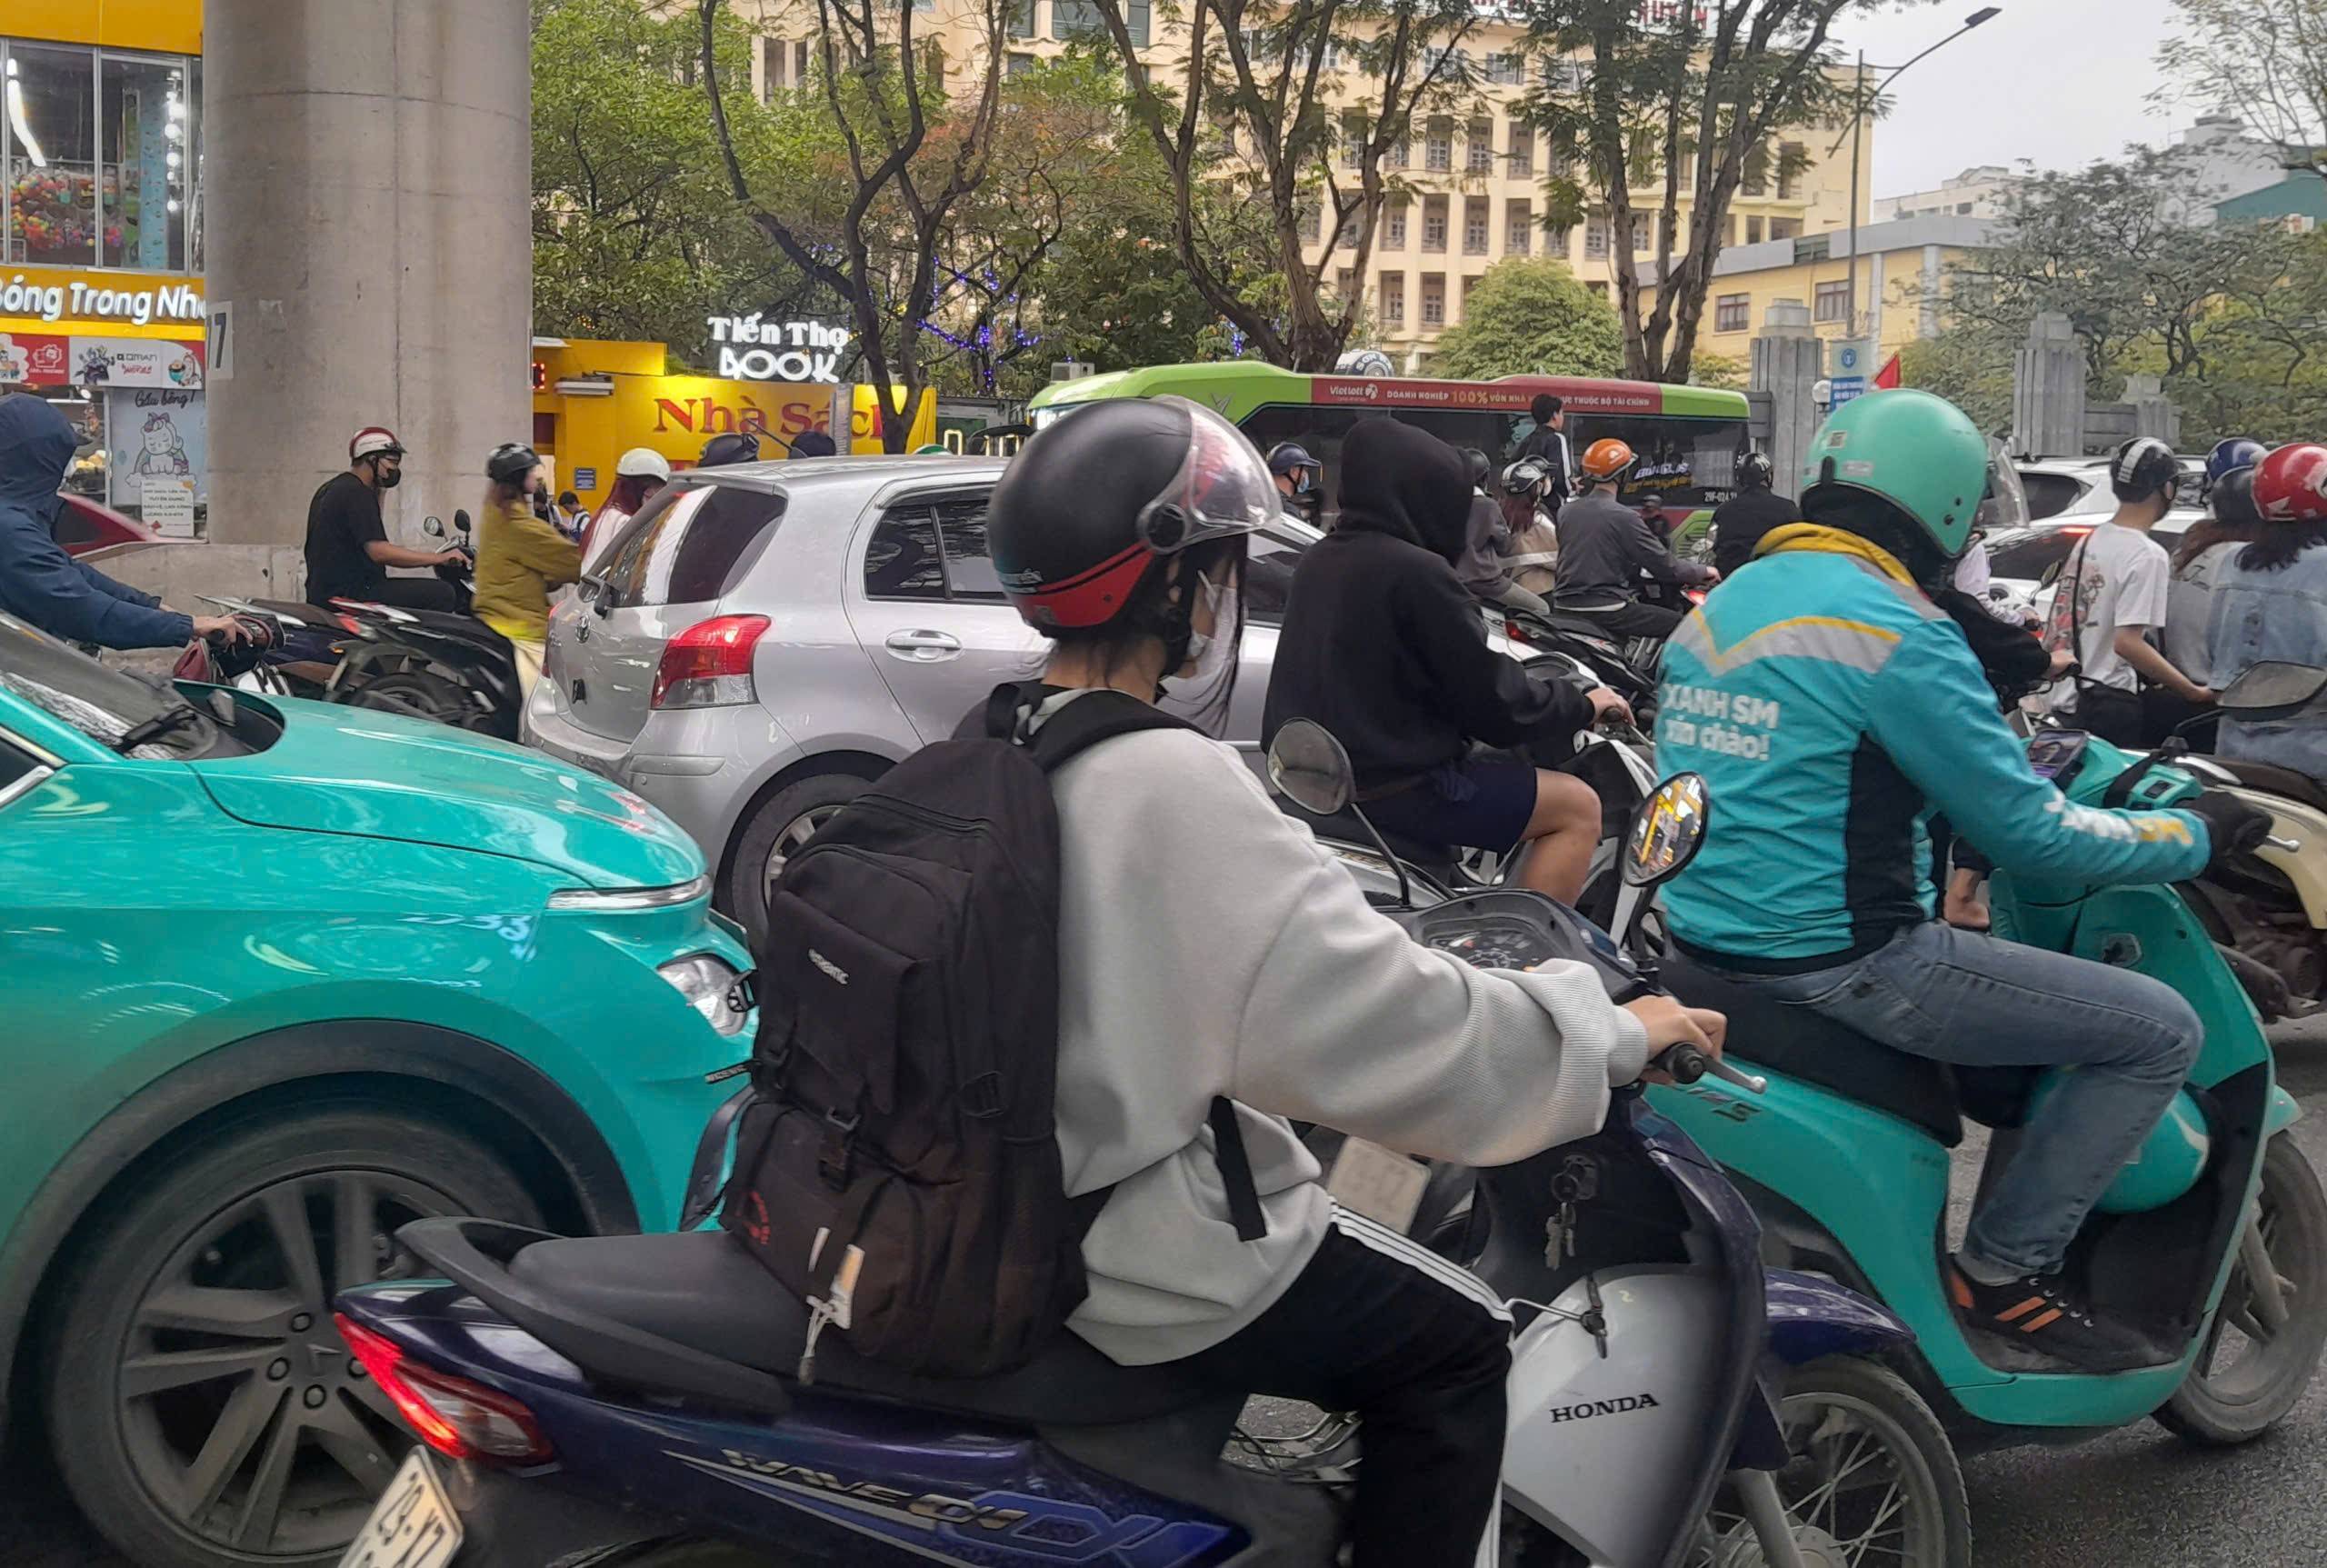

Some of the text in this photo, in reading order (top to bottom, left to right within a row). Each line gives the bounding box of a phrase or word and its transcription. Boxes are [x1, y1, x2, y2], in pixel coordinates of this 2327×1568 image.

[69, 282, 153, 325] Trong
[707, 312, 849, 355] Tiến Thọ
[1330, 385, 1364, 396] Vietlott
[1386, 390, 1417, 399] DOANH
[1419, 390, 1449, 400] NGHIỆP
[1453, 390, 1488, 404] 100%
[654, 395, 766, 434] Nhà
[1663, 683, 1780, 729] XANH SM
[1700, 723, 1771, 762] chào!
[1551, 1393, 1660, 1423] HONDA
[721, 1448, 912, 1503] WAVE
